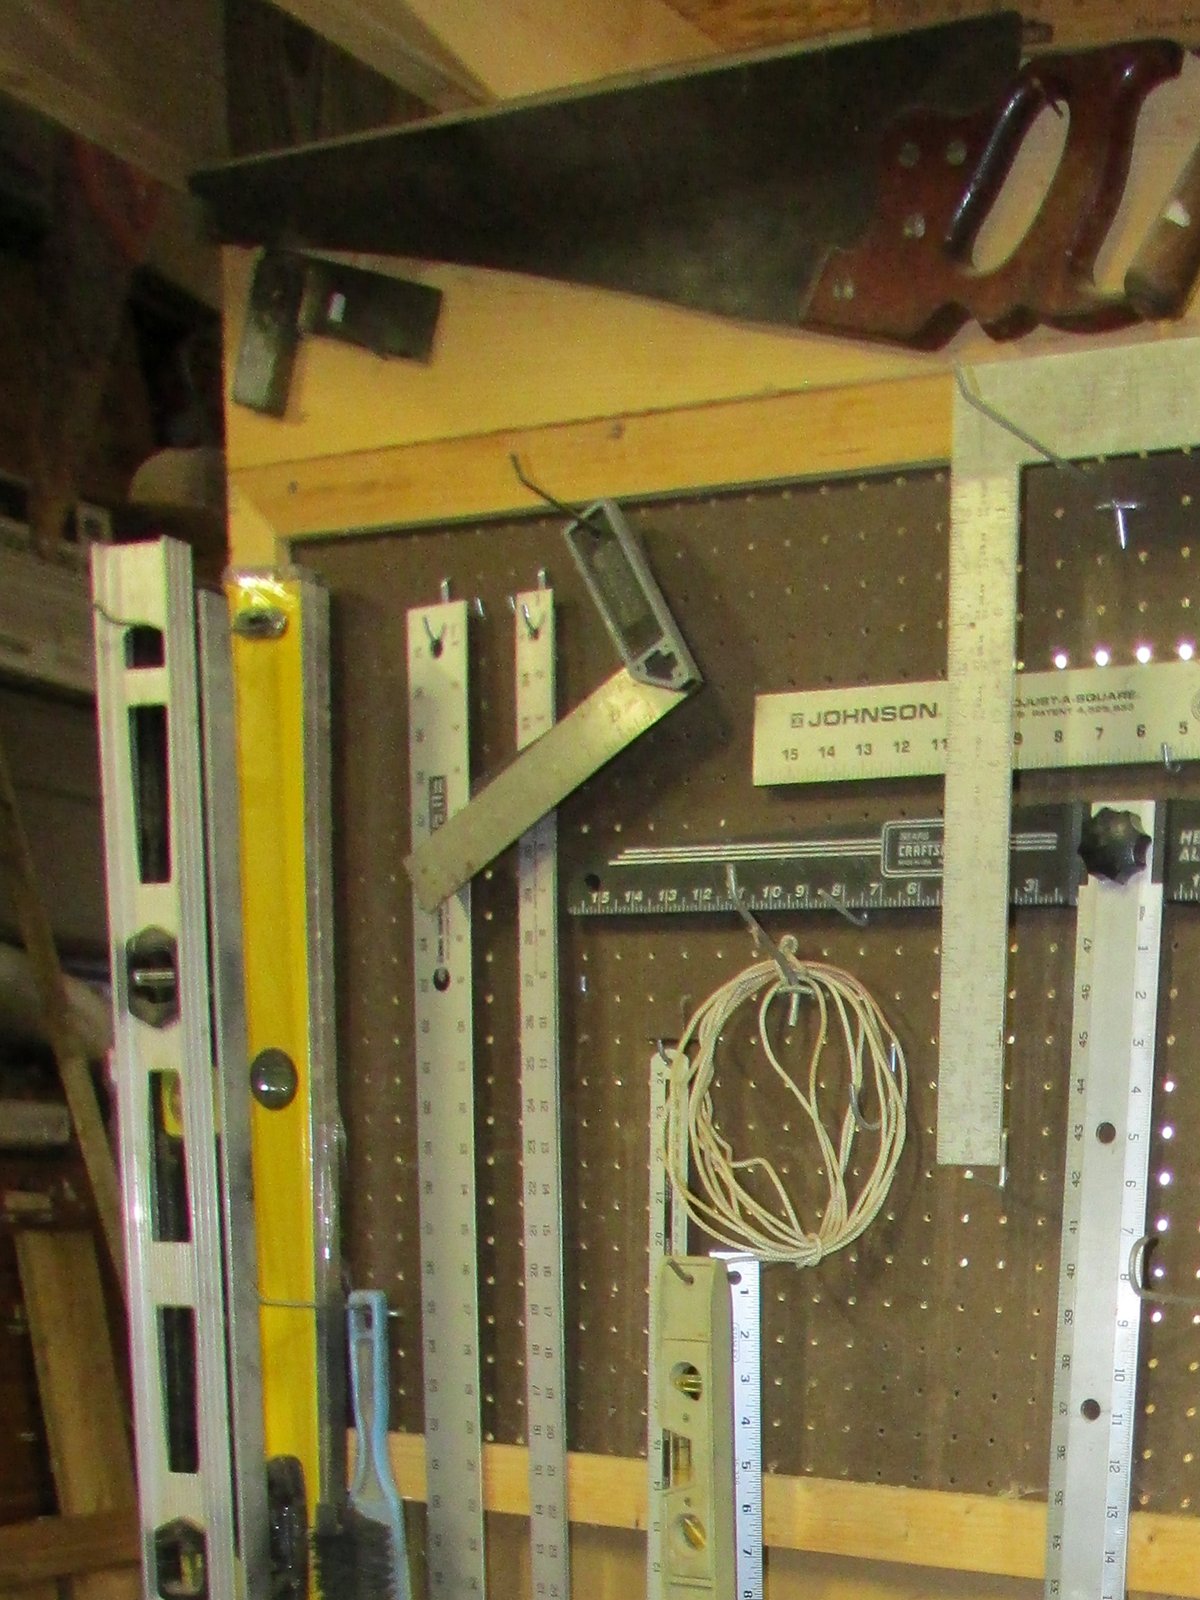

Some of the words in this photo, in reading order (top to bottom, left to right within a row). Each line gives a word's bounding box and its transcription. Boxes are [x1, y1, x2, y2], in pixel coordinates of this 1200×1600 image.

[808, 702, 937, 727] JOHNSON
[782, 748, 798, 760] 15
[819, 746, 835, 758] 14
[856, 744, 872, 756] 13
[893, 741, 910, 753] 12
[1054, 729, 1063, 743] 8
[1096, 726, 1103, 740] 7
[1137, 724, 1146, 737] 6
[1179, 721, 1188, 734] 5
[591, 891, 610, 904] 15
[624, 890, 643, 902] 14
[658, 889, 678, 902] 13
[693, 888, 712, 900] 12
[762, 885, 782, 898] 10
[795, 885, 805, 898] 9
[831, 883, 841, 897] 8
[869, 884, 878, 896] 7
[907, 882, 917, 895] 6
[1024, 878, 1036, 892] 3
[1081, 984, 1090, 1000] 46
[1136, 991, 1147, 1000] 2
[1079, 1031, 1088, 1047] 45
[1133, 1039, 1144, 1047] 3
[657, 1071, 664, 1084] 24
[1077, 1078, 1084, 1094] 44
[1131, 1086, 1142, 1095] 4
[657, 1105, 664, 1119] 23
[1125, 1180, 1136, 1188] 6
[656, 1191, 663, 1204] 21
[655, 1232, 663, 1246] 20
[1120, 1273, 1130, 1282] 8
[1117, 1320, 1128, 1328] 9
[740, 1331, 750, 1339] 2
[740, 1374, 750, 1383] 3
[1114, 1368, 1125, 1382] 10
[741, 1417, 751, 1425] 4
[1112, 1413, 1123, 1426] 11
[741, 1461, 751, 1470] 5
[1109, 1459, 1120, 1473] 12
[742, 1504, 751, 1513] 6
[1107, 1505, 1118, 1519] 13
[743, 1548, 753, 1556] 7
[1105, 1551, 1116, 1564] 14
[654, 1562, 661, 1573] 12
[744, 1590, 753, 1598] 8
